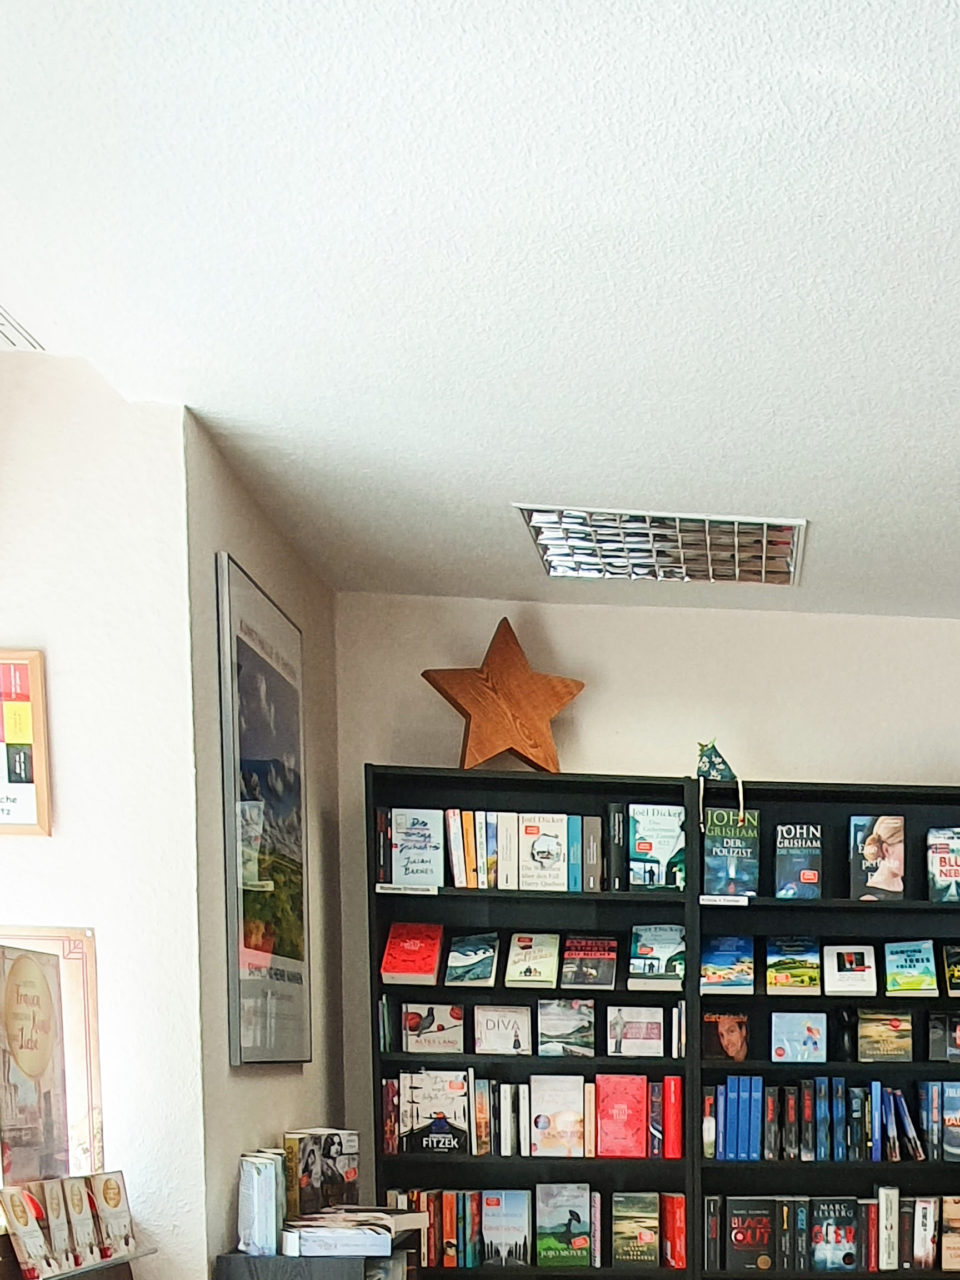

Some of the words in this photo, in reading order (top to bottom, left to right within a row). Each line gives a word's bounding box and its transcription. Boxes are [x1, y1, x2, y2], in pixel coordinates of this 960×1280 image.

[706, 810, 758, 827] JOHN
[706, 827, 758, 837] GRISHAM
[777, 825, 821, 840] JOHN
[723, 838, 742, 848] DER
[777, 839, 821, 848] GRISHAM
[712, 848, 752, 857] POLIZIST
[485, 1018, 520, 1031] DIVA
[422, 1136, 459, 1149] FITZEK
[731, 1217, 770, 1228] BLACK
[812, 1225, 855, 1244] GIER
